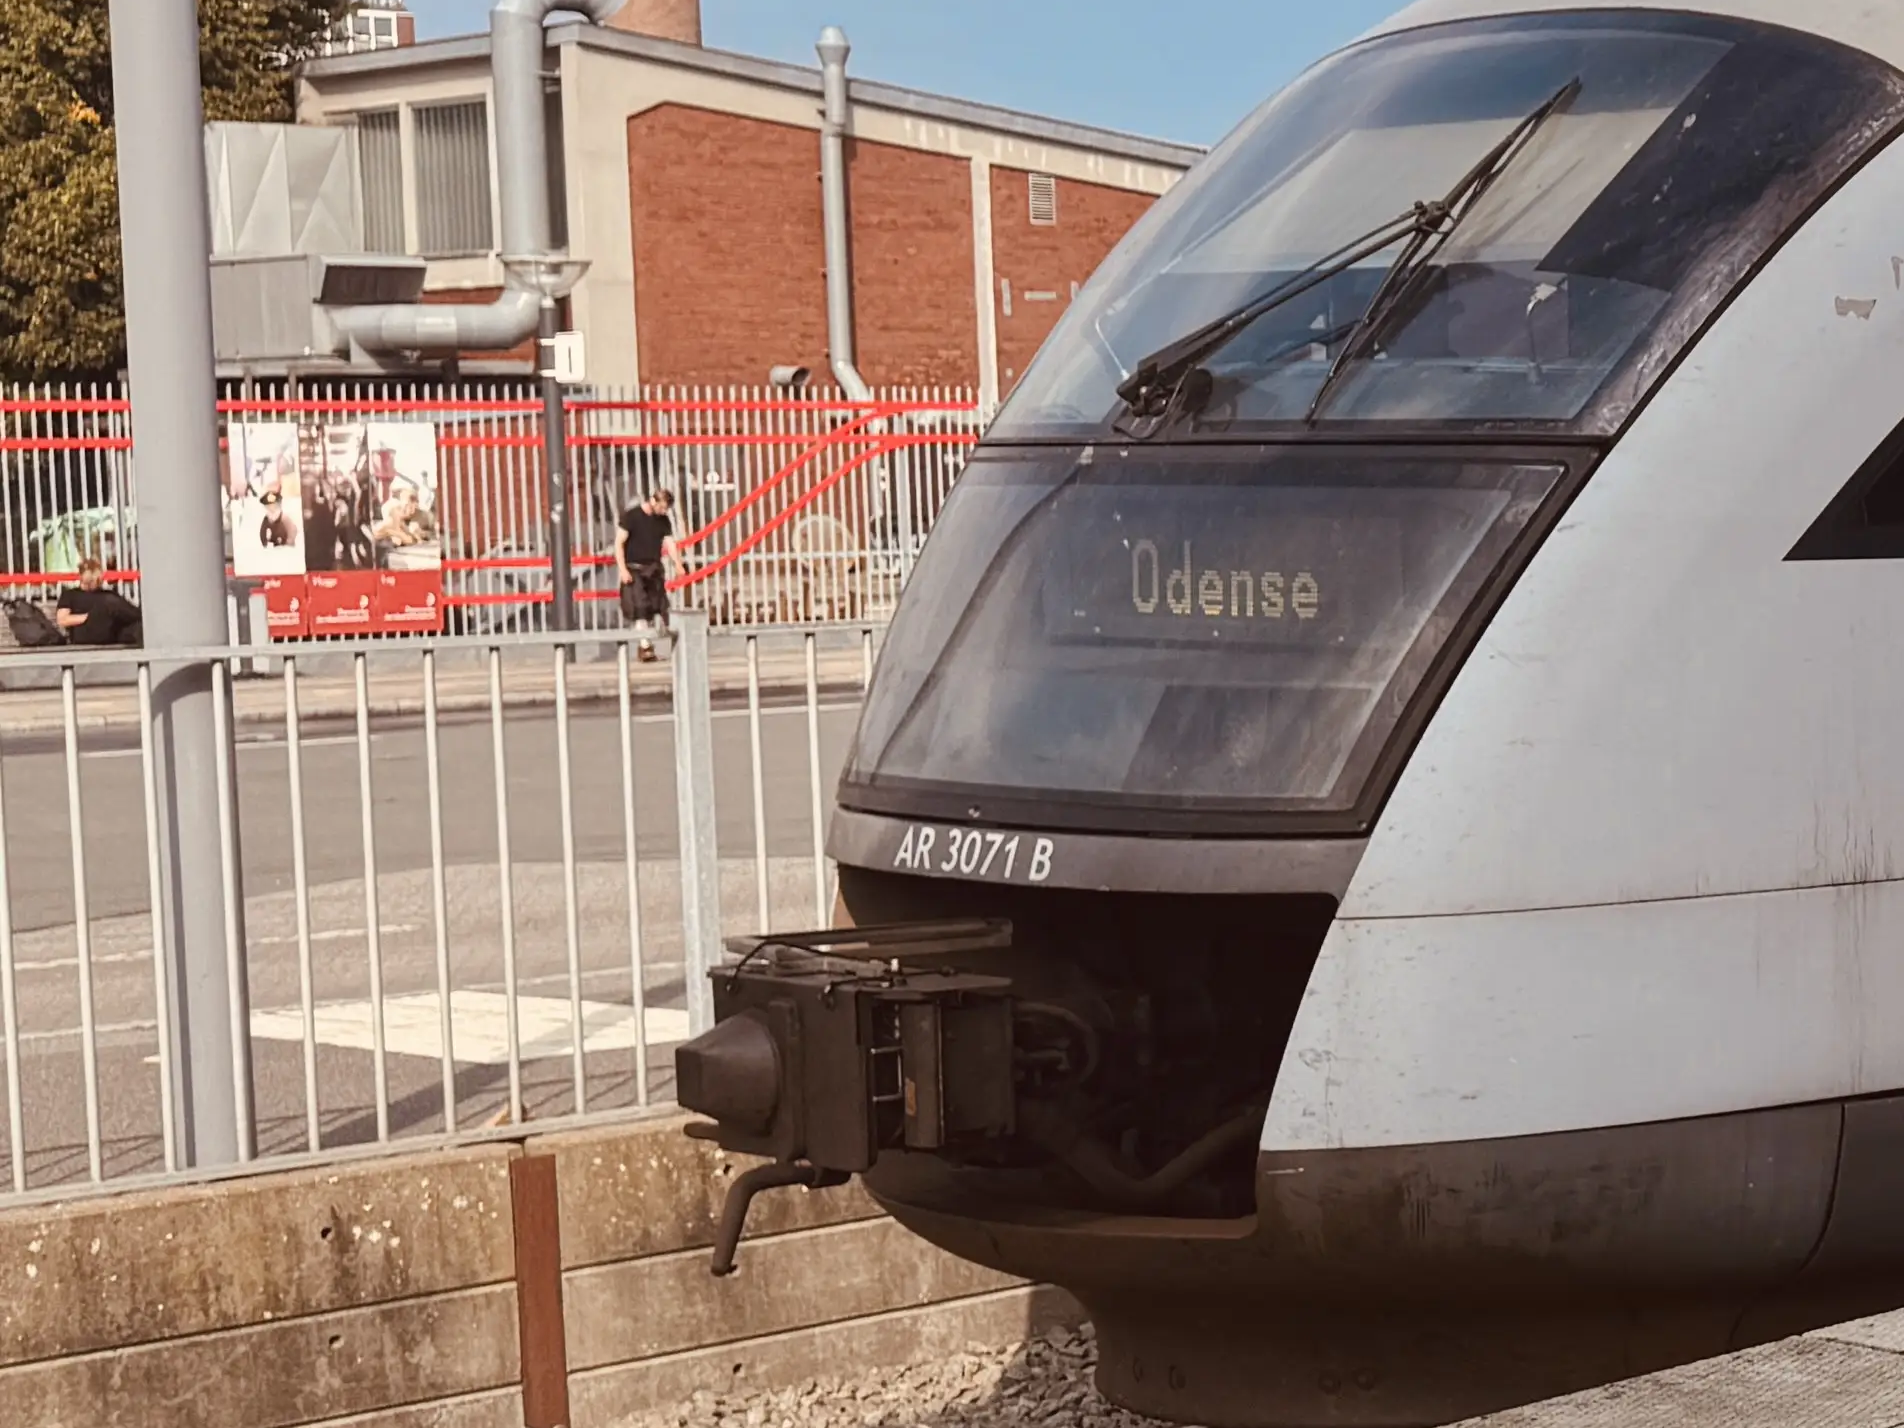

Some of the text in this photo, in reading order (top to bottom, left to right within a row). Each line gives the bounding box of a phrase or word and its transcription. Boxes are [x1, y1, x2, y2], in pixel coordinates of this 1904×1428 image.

[1132, 539, 1319, 619] Odense
[893, 825, 1054, 882] AR 3071 B
